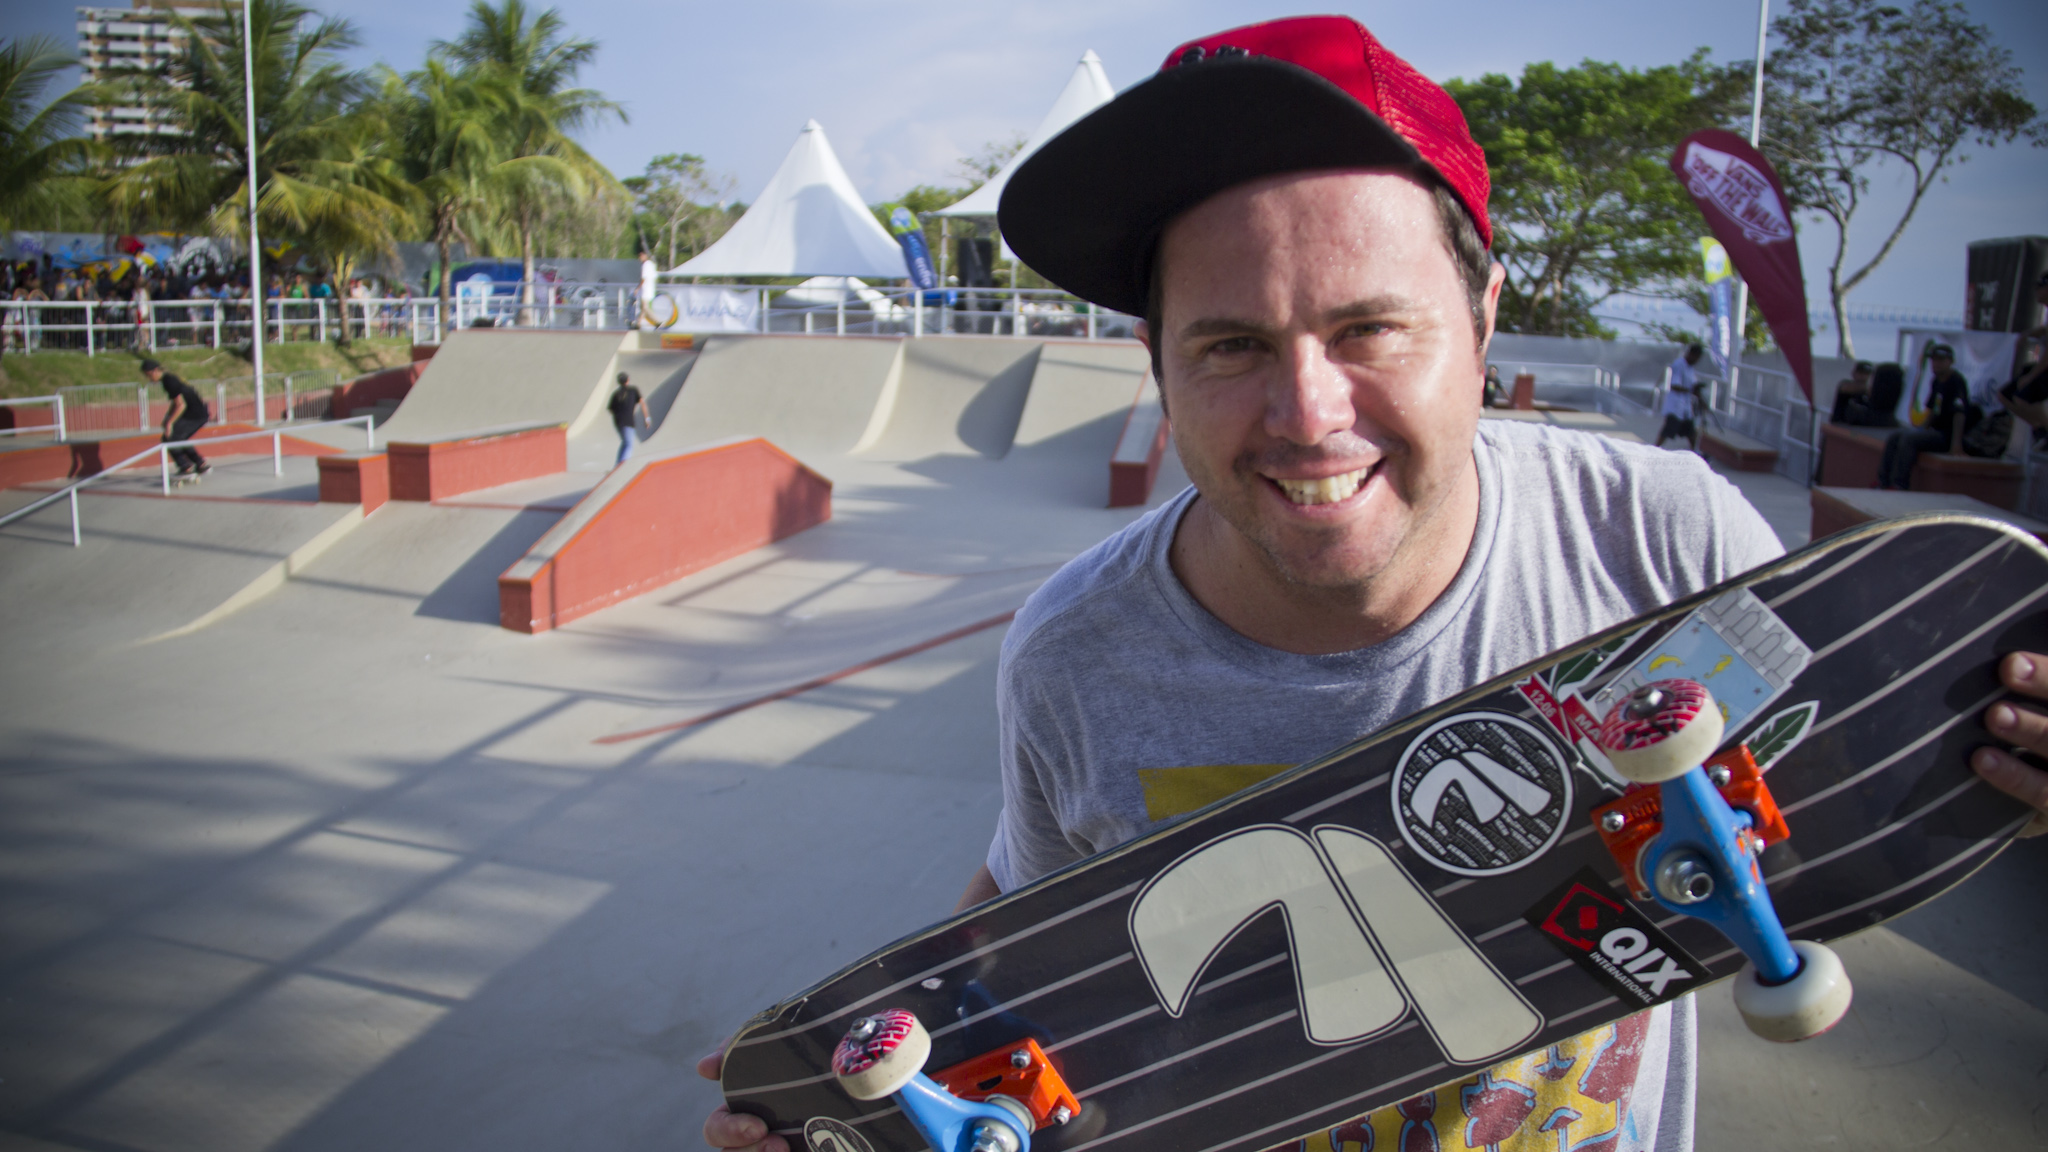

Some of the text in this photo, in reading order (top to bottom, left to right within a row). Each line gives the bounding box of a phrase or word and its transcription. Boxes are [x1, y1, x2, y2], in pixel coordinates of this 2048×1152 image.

[1714, 175, 1748, 213] THE
[1724, 156, 1768, 199] VANS
[1529, 689, 1557, 718] 12-06
[1589, 951, 1654, 1004] INTERNATIONAL
[1599, 926, 1694, 997] QIX
